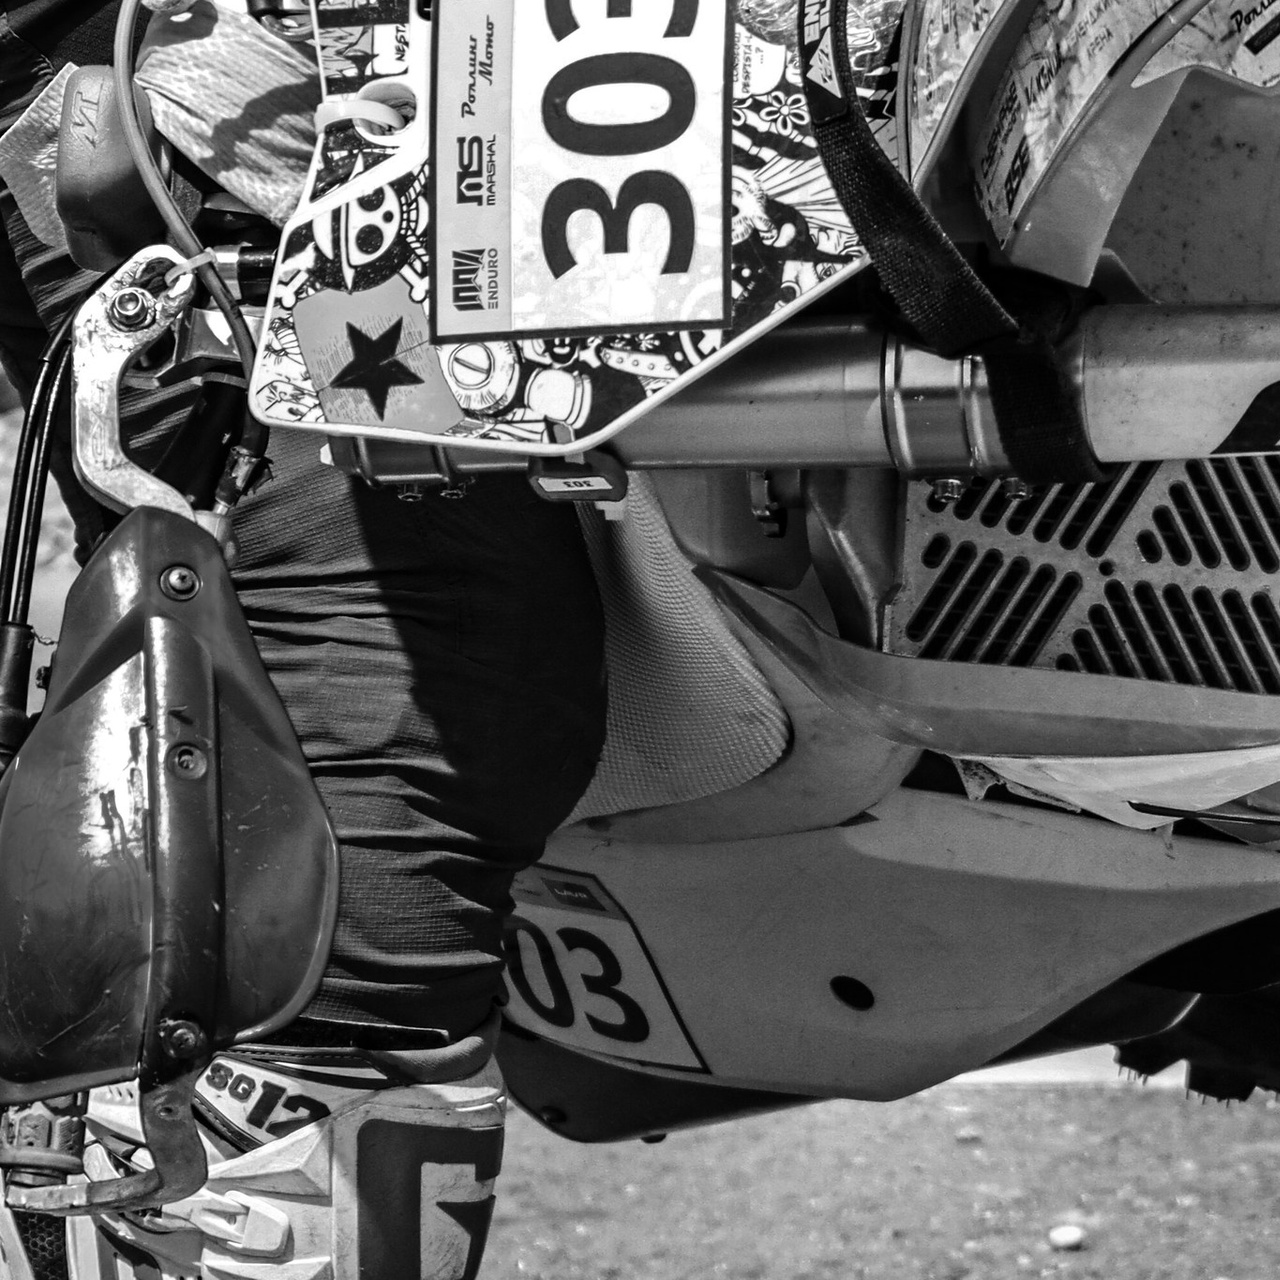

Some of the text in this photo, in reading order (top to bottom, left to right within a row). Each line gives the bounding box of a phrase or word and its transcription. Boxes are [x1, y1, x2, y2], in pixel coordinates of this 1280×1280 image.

[480, 12, 498, 87] Мото
[486, 134, 498, 207] MARSHAL
[487, 246, 499, 310] ENDURO
[562, 480, 595, 488] 303
